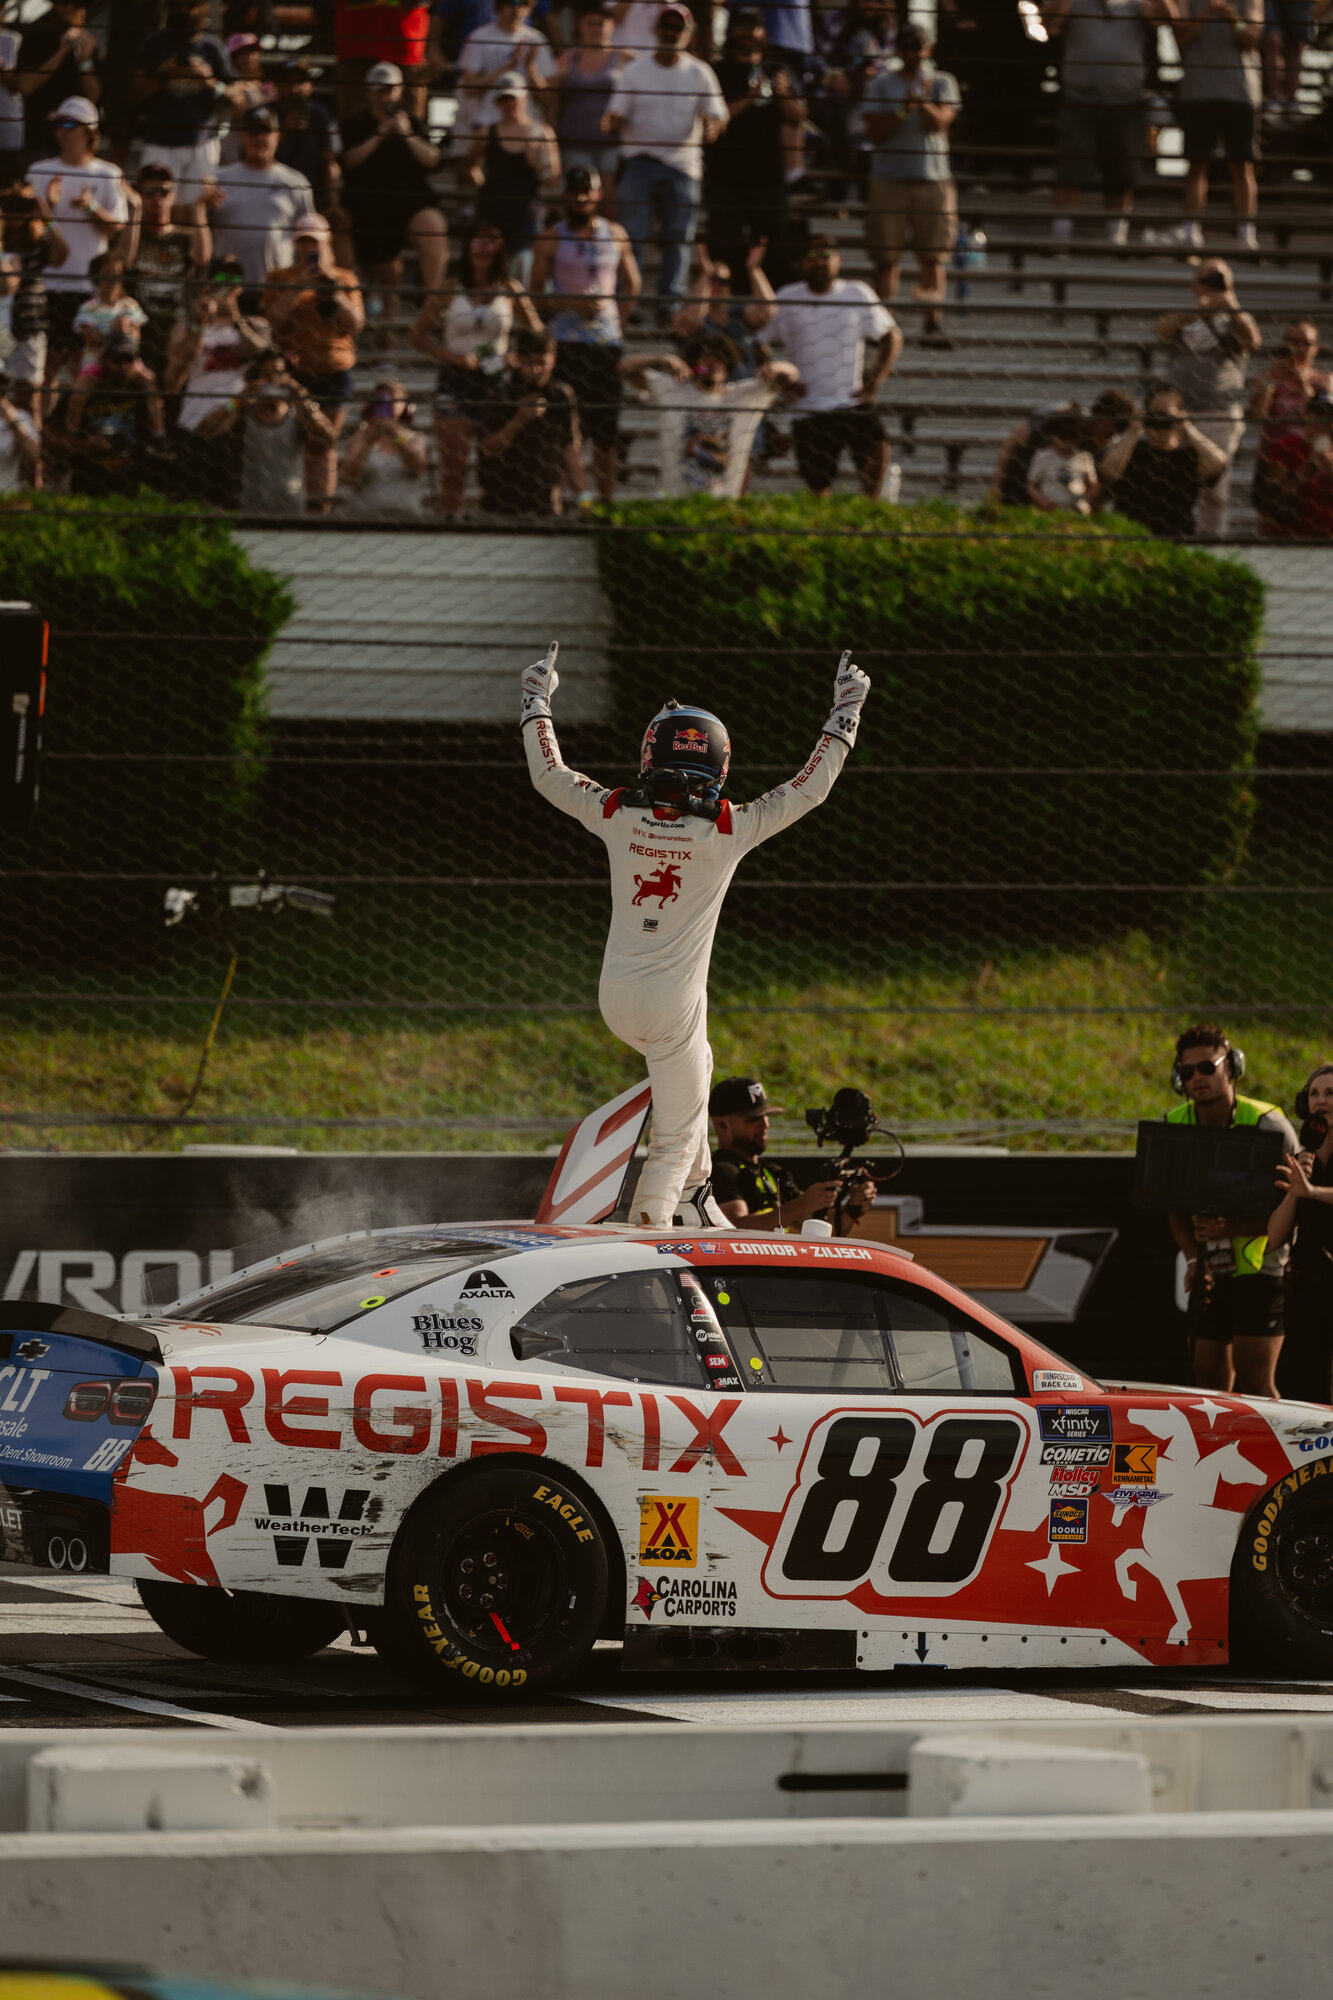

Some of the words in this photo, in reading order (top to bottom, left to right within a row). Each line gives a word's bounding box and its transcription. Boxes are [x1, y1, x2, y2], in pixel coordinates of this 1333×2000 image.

[673, 741, 691, 751] Red
[691, 742, 708, 753] Bull
[791, 733, 833, 790] REGISTIX
[641, 816, 685, 829] Registix.com
[629, 842, 692, 860] REGISTIX
[730, 1242, 798, 1257] CONNOR
[809, 1245, 873, 1260] ZILISCH
[459, 1289, 516, 1300] AXALTA
[410, 1313, 484, 1332] Blues
[421, 1331, 477, 1357] Hog
[708, 1357, 726, 1366] SEM
[1049, 1372, 1076, 1381] NASCAR
[170, 1366, 748, 1477] REGISTIX
[1051, 1415, 1100, 1434] xfinity
[1299, 1436, 1333, 1452] GO
[0, 1445, 25, 1460] Dent
[21, 1447, 73, 1468] Showroom
[82, 1438, 133, 1472] 88
[1042, 1448, 1111, 1463] COMETIC
[1051, 1466, 1101, 1487] Holley
[1113, 1475, 1154, 1483] KENNAMETAL
[1048, 1483, 1094, 1496] MSD
[1114, 1490, 1135, 1498] FIVE
[1137, 1491, 1158, 1499] STAR
[782, 1416, 1021, 1583] 88
[0, 1507, 23, 1530] LET
[533, 1485, 594, 1543] EAGLE
[1054, 1510, 1083, 1518] SUNOCO
[1253, 1457, 1333, 1571] GOODYEA
[254, 1518, 371, 1536] WeatherTech
[1051, 1526, 1085, 1535] ROOKIE
[642, 1547, 693, 1561] KOA
[656, 1576, 738, 1599] CAROLINA
[664, 1597, 737, 1617] CARPORTS
[413, 1584, 527, 1686] GOODYEAR
